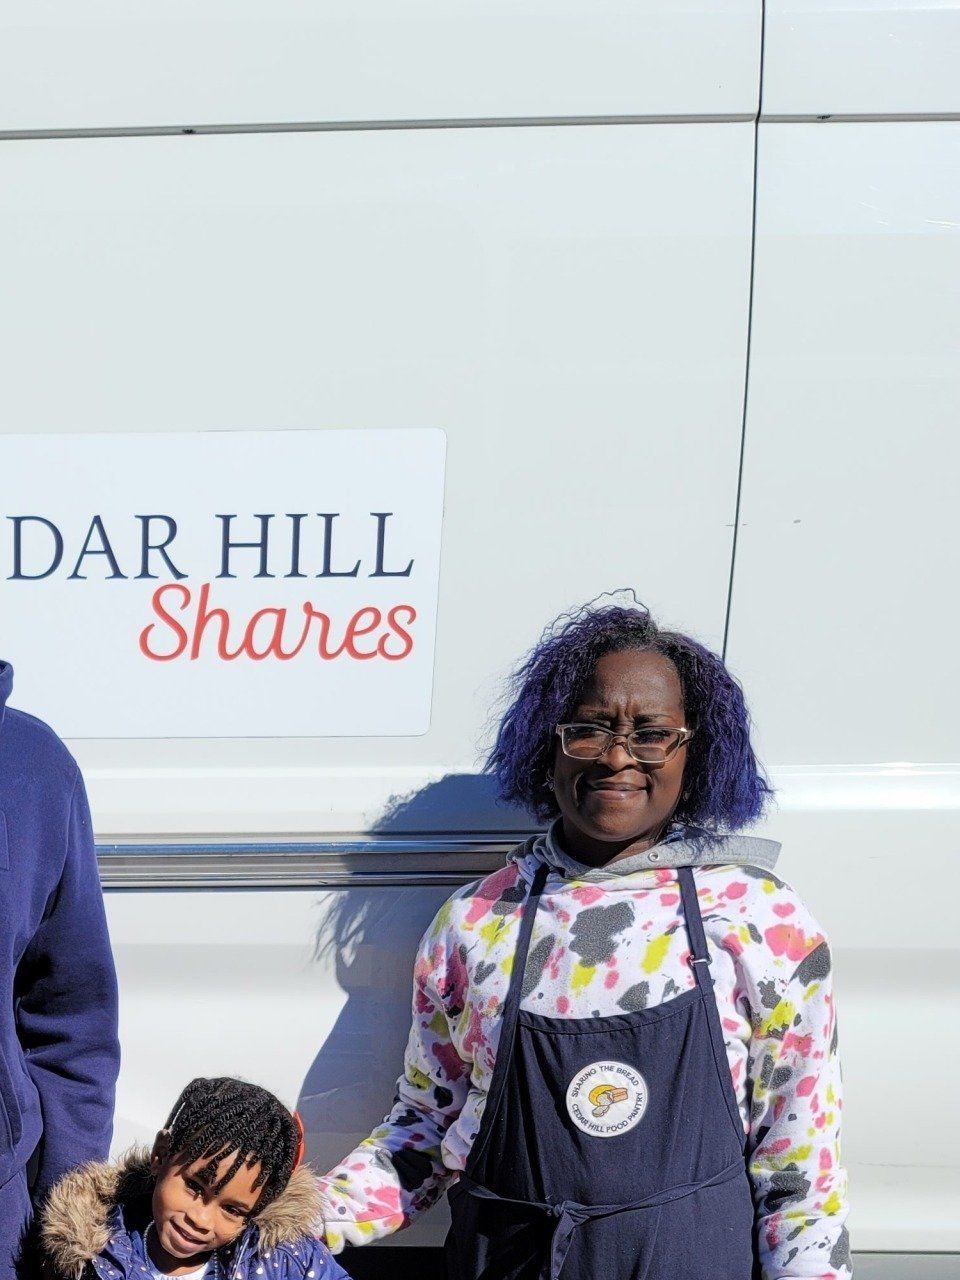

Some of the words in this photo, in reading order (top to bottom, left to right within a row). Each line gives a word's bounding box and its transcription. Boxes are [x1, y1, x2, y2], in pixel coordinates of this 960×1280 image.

[214, 512, 415, 579] HILL
[138, 583, 417, 663] Shares
[599, 1065, 615, 1073] THE
[616, 1067, 639, 1087] BREAD
[571, 1103, 589, 1127] CEDAR
[588, 1122, 605, 1132] HILL
[627, 1092, 644, 1121] PANTRY
